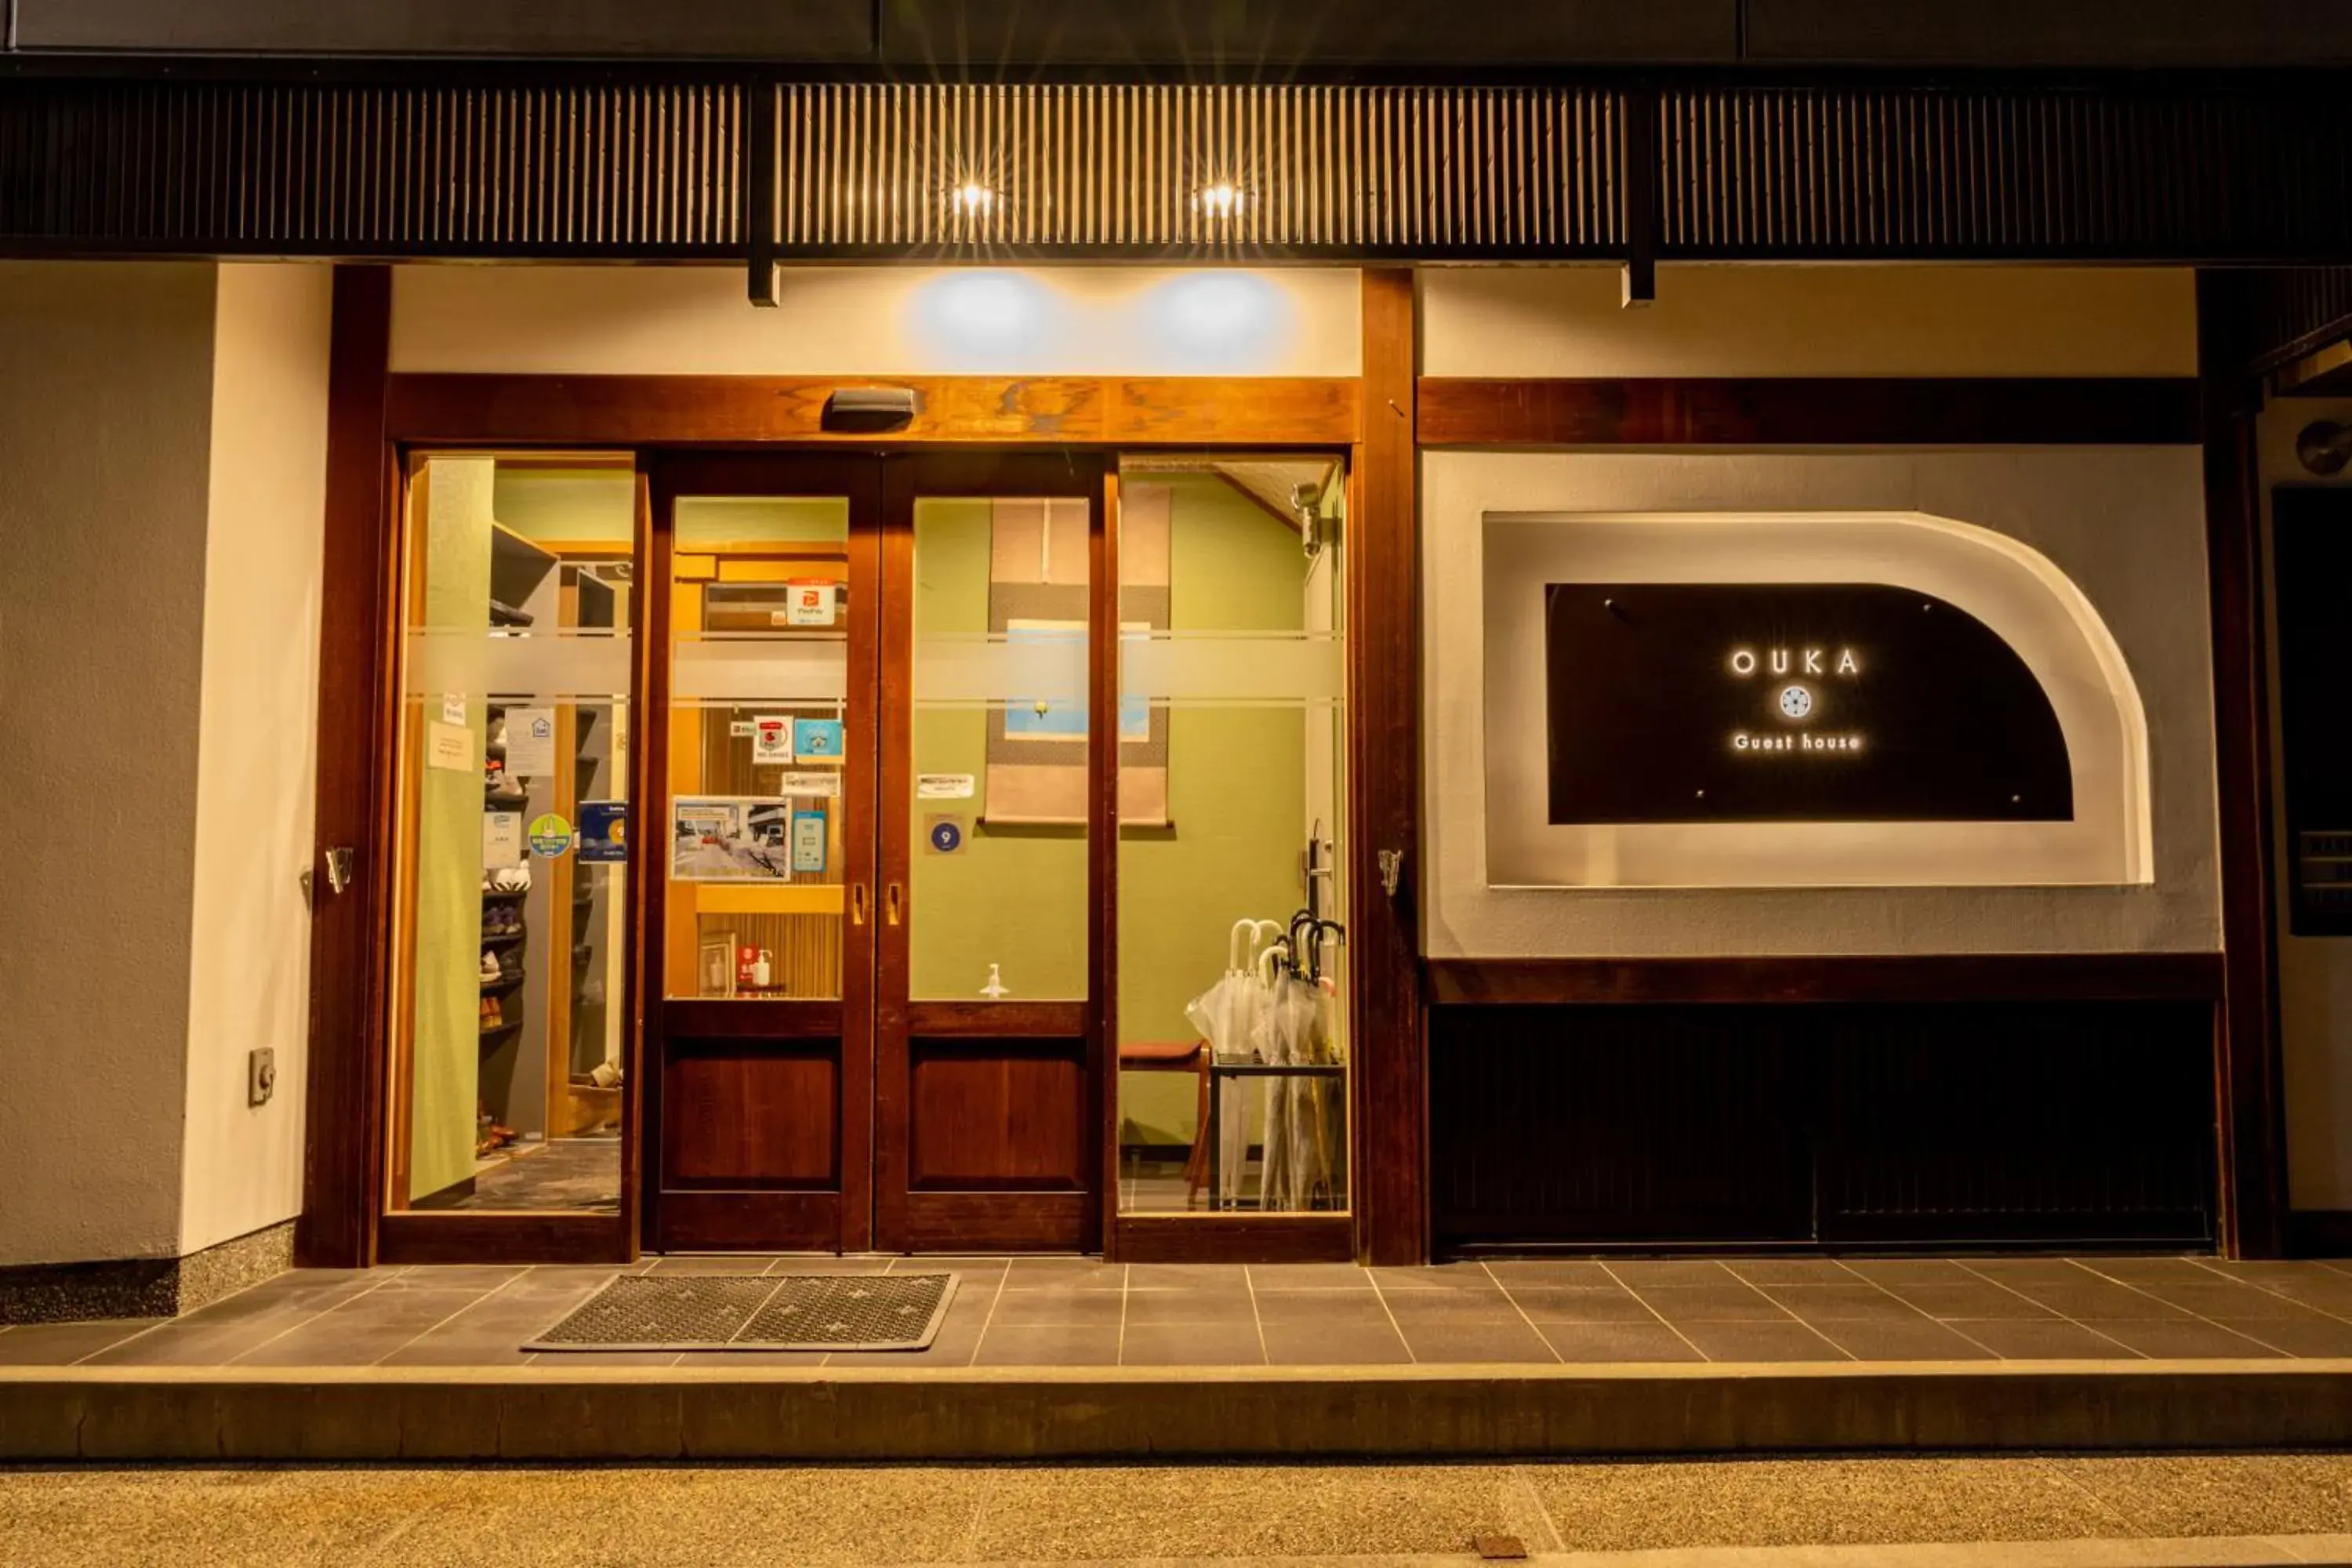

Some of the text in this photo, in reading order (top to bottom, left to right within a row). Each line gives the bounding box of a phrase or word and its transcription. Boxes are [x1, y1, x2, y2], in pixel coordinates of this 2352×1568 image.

[1731, 648, 1857, 674] OUKA
[1733, 733, 1860, 750] Guest house
[941, 830, 952, 844] 9
